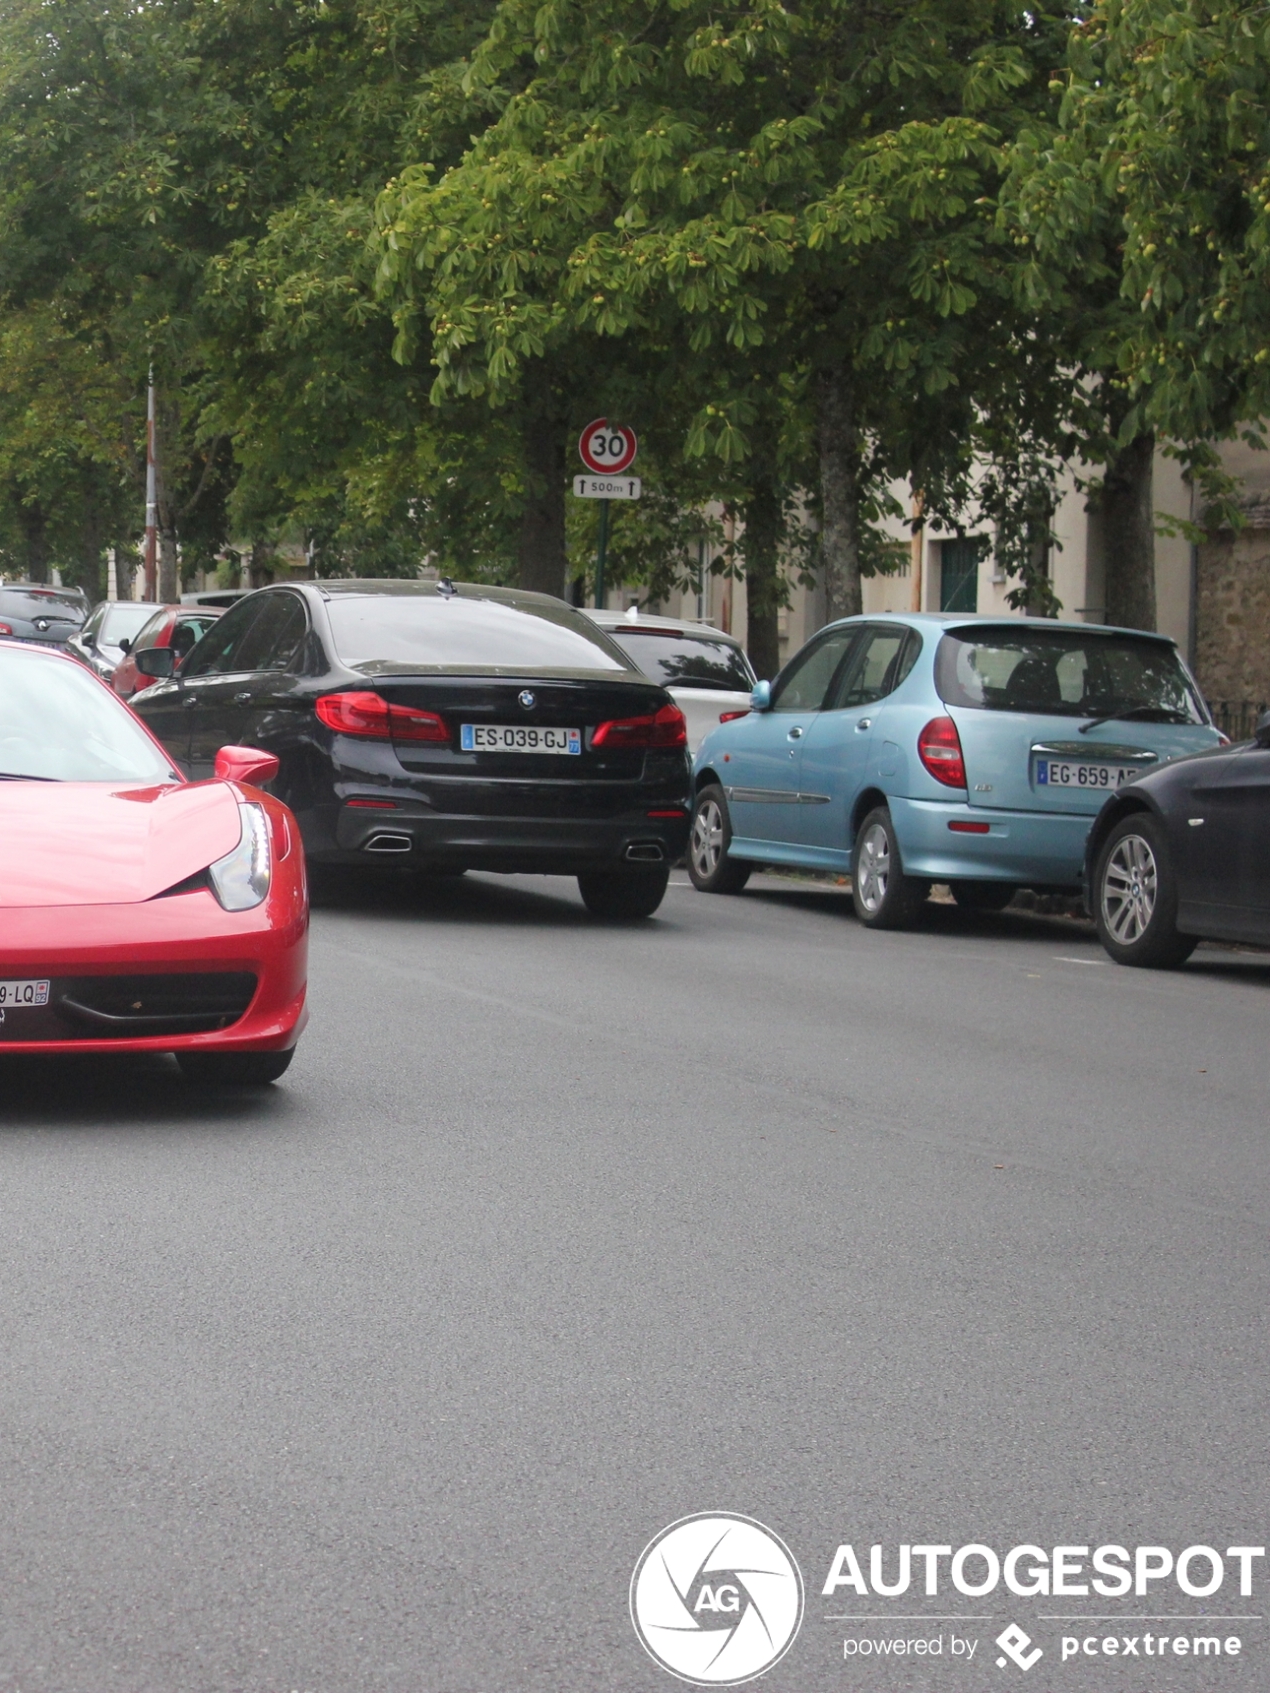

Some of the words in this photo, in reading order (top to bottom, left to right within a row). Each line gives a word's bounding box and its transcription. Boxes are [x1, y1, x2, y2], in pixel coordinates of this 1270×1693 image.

[592, 434, 624, 457] 30
[591, 482, 623, 493] 500m
[474, 727, 567, 749] ES-039-GJ
[35, 994, 46, 1003] 92
